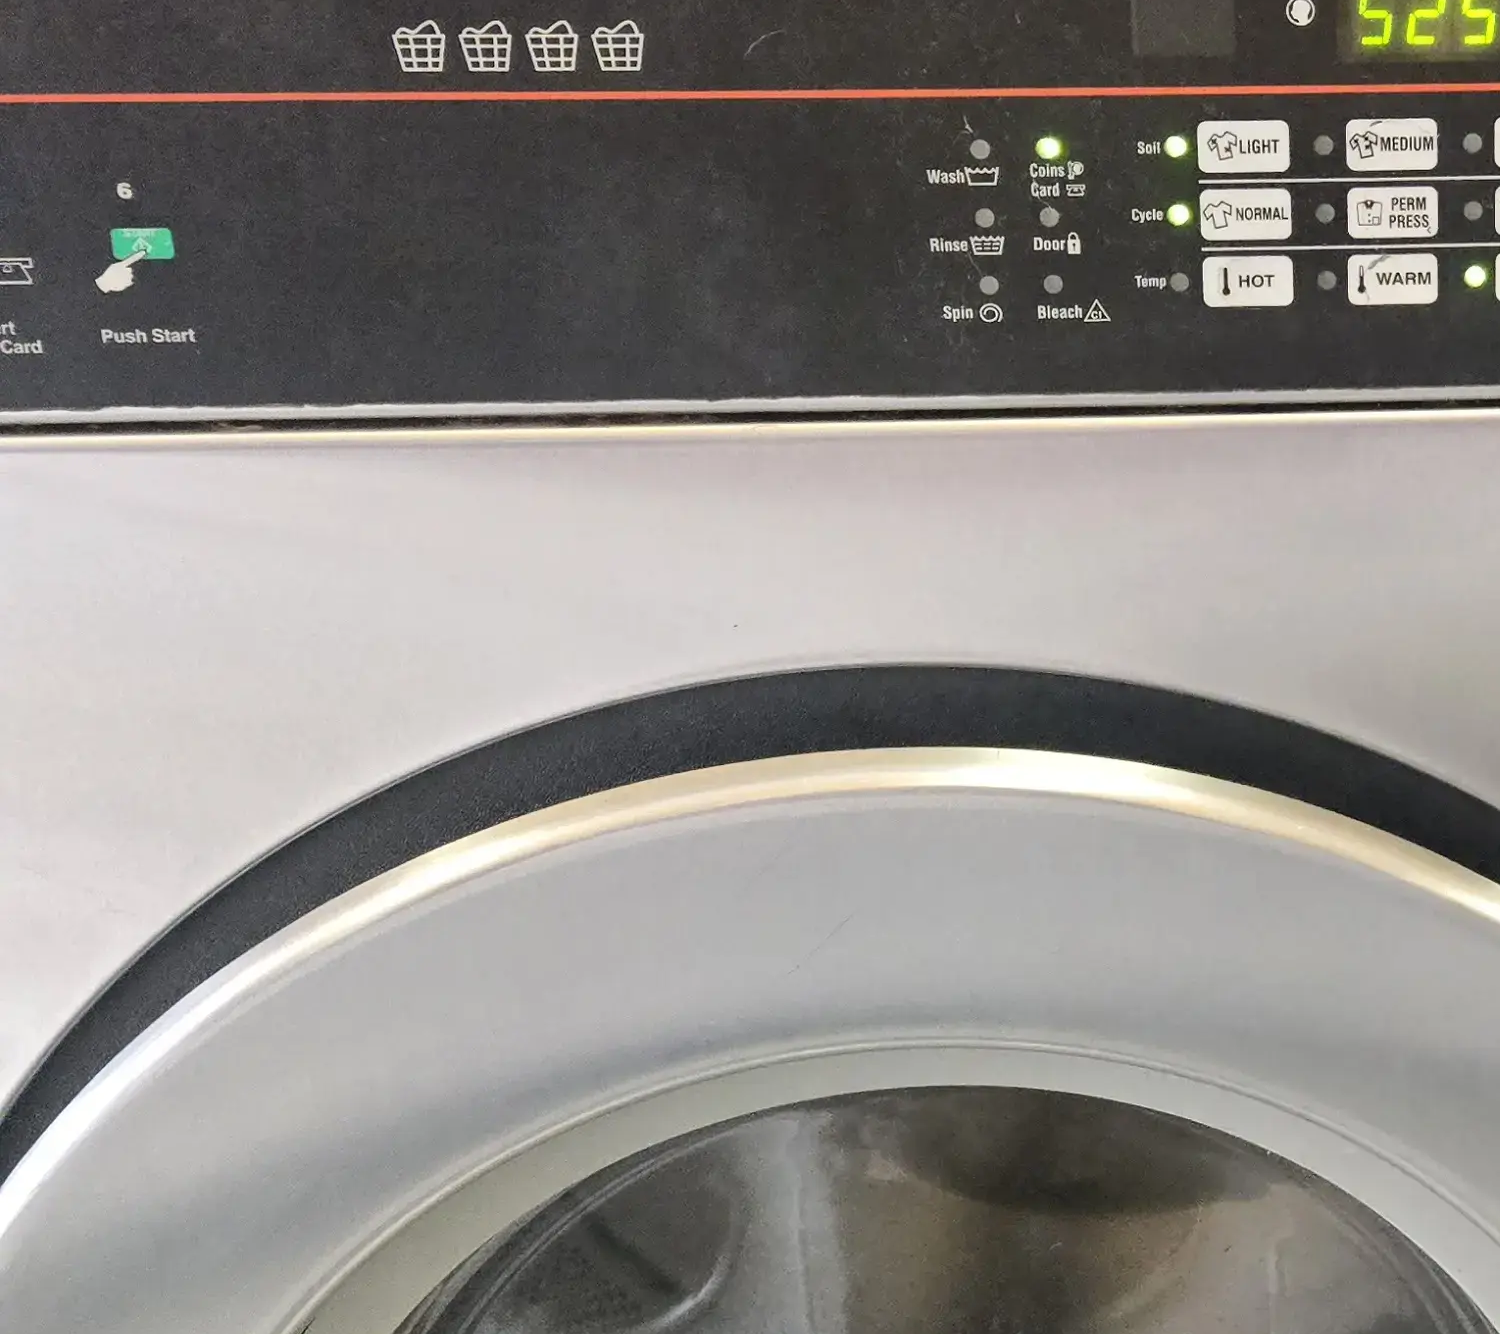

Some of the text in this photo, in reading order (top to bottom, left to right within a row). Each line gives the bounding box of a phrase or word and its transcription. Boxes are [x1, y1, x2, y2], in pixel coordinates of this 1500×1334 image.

[1137, 141, 1161, 155] Soil
[1239, 139, 1280, 154] LIGHT
[1380, 136, 1434, 152] MEDIUM
[926, 169, 965, 184] Wash
[1029, 163, 1065, 178] Coins
[116, 182, 133, 200] 6
[1031, 183, 1060, 197] Card
[1391, 197, 1427, 211] PERM
[1131, 208, 1164, 222] Cycle
[1236, 207, 1289, 220] NORMAL
[1389, 213, 1430, 228] PRESS
[930, 238, 968, 252] Rinse
[1033, 237, 1065, 251] Door
[1135, 275, 1167, 289] Temp
[1239, 274, 1275, 288] HOT
[1376, 272, 1432, 286] WARM
[943, 306, 974, 321] Spin
[1037, 305, 1083, 319] Bleach
[100, 328, 196, 344] Push Start
[0, 339, 43, 354] Card
